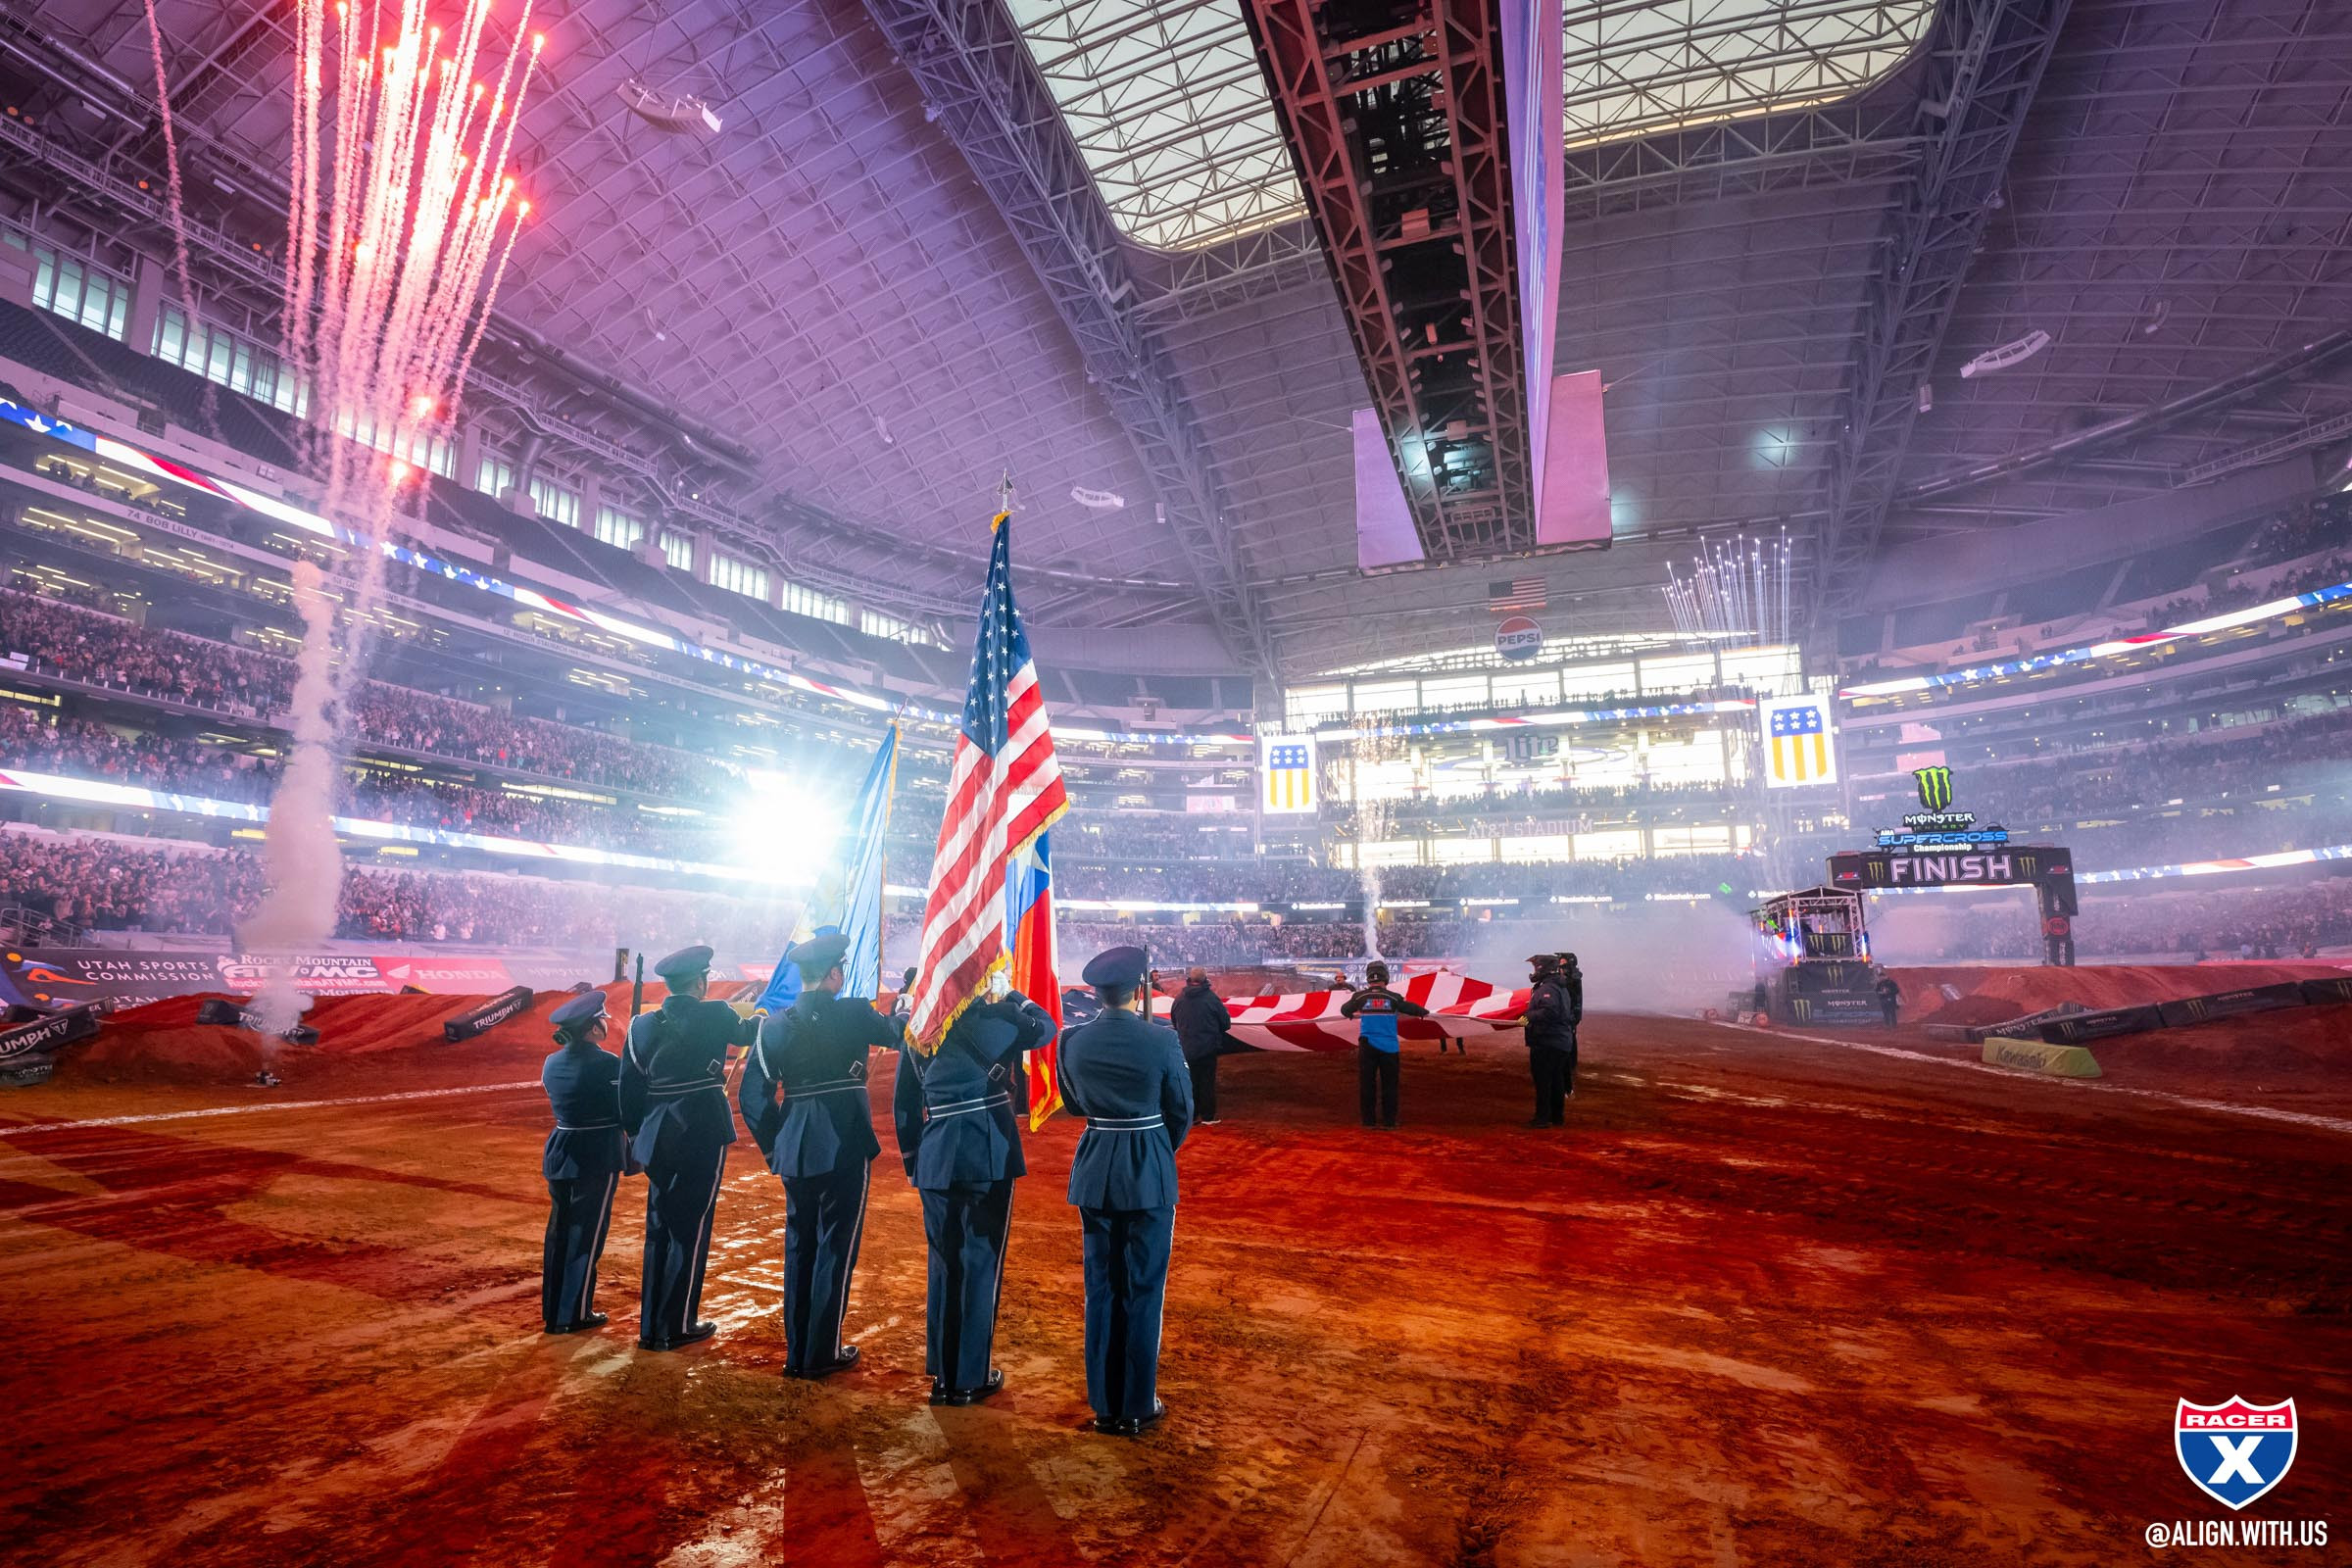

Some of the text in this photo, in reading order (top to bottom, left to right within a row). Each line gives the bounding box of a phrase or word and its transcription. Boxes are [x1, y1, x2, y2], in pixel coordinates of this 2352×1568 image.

[127, 510, 197, 538] 74 BOB LILLY
[1497, 633, 1541, 645] PEPSI
[1904, 812, 1975, 825] MONSTER
[1468, 819, 1593, 840] AT&T STADIUM
[1878, 831, 2008, 846] SUPERCROSS
[1913, 843, 1973, 853] Championship
[1890, 855, 2013, 882] FINISH
[1653, 891, 1711, 901] Blockchain.com
[77, 960, 210, 971] UTAH SPORTS
[296, 956, 371, 966] MOUNTAIN
[85, 971, 216, 981] COMMISSION
[415, 969, 504, 980] HONDA
[1827, 1000, 1868, 1008] MONSTER
[473, 1004, 514, 1029] TRIUMPH
[1995, 1016, 2043, 1036] MONSTER
[1995, 1045, 2047, 1069] Kawasaki
